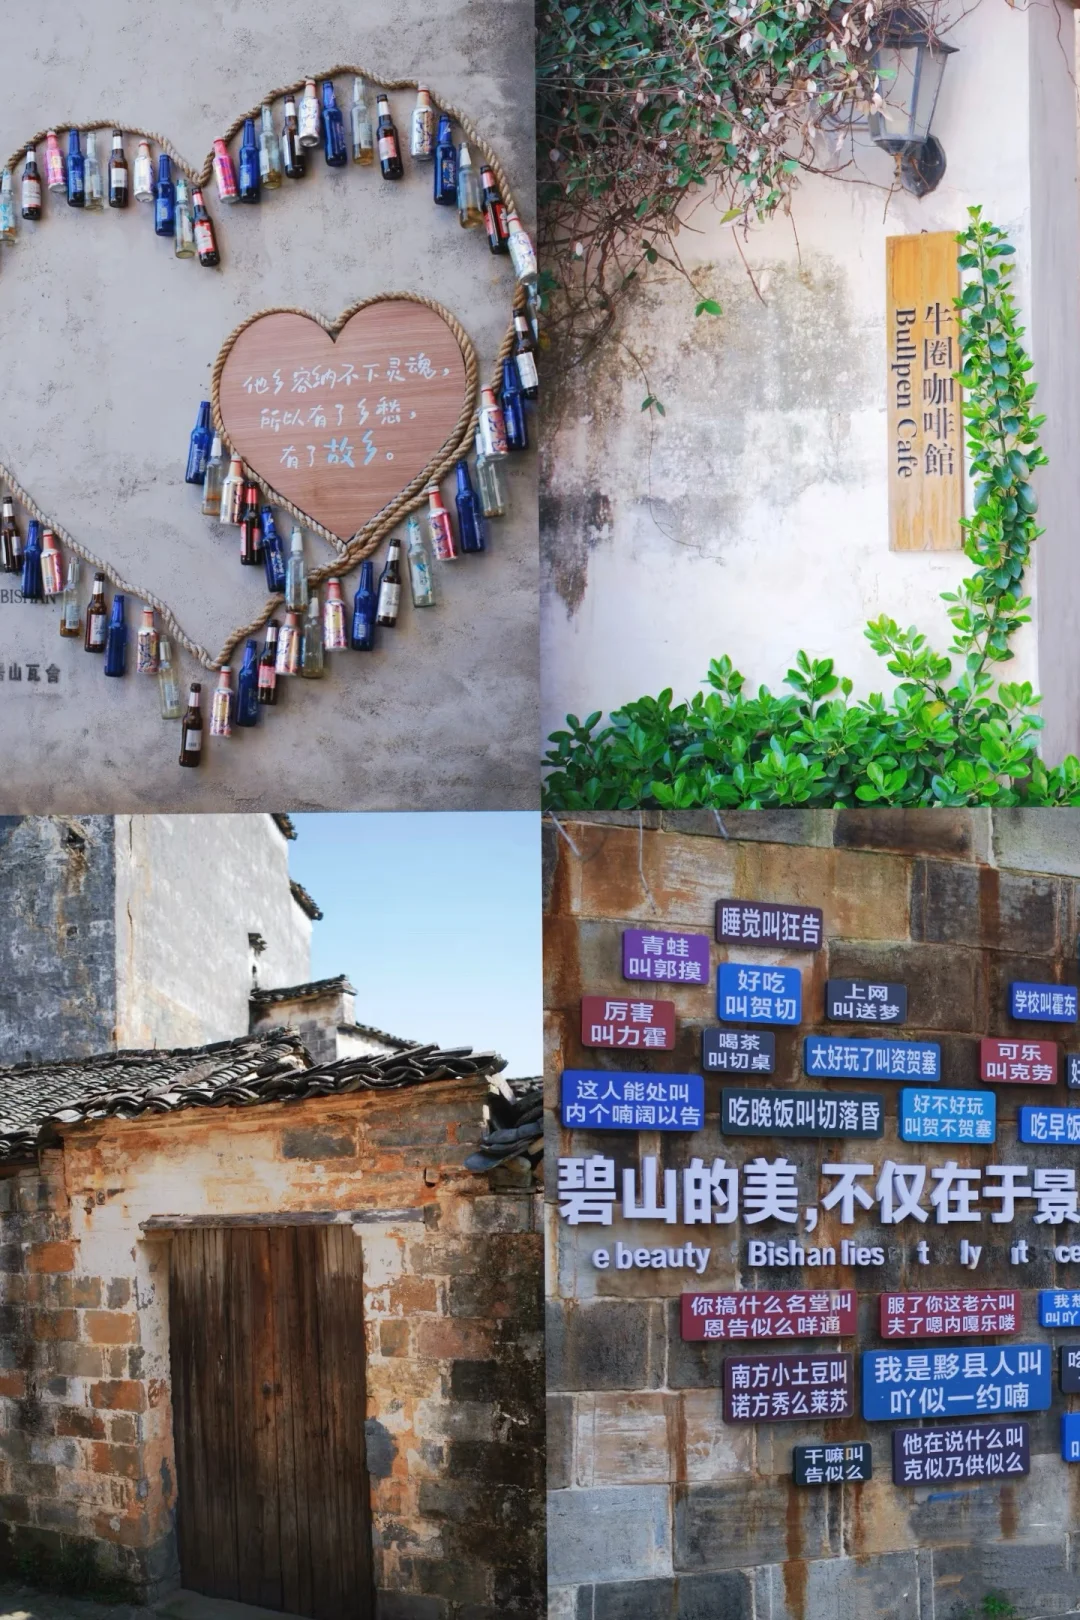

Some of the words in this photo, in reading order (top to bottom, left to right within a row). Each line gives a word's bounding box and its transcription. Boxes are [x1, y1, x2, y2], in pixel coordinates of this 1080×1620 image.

[891, 308, 916, 409] Bullpen
[923, 303, 954, 476] 牛圈咖啡館
[897, 418, 917, 478] Cafe
[722, 907, 820, 944] 睡觉叫狂告
[641, 936, 689, 957] 青蛙
[629, 958, 702, 981] 叫郭摸
[738, 970, 786, 994] 好吃
[844, 983, 889, 1001] 上网
[604, 1001, 654, 1023] 厉害
[726, 996, 797, 1020] 叫贺切
[833, 1002, 900, 1020] 叫送梦
[1015, 990, 1076, 1016] 学校叫霍东
[591, 1025, 667, 1047] 叫力霍
[719, 1033, 760, 1051] 喝茶
[708, 1052, 770, 1070] 叫切桌
[811, 1044, 937, 1075] 太好玩了叫资贺塞
[998, 1043, 1041, 1061] 可乐
[986, 1062, 1053, 1081] 叫克劳
[576, 1080, 689, 1103] 这人能处叫
[566, 1103, 701, 1126] 内个喃阔以告
[728, 1096, 880, 1131] 吃晚饭叫切落昏
[913, 1094, 983, 1115] 好不好玩
[905, 1118, 992, 1138] 叫贺不贺塞
[616, 1241, 711, 1274] beauty
[748, 1239, 836, 1266] Bishan
[840, 1239, 885, 1266] lies
[691, 1293, 852, 1316] 你搞什么名堂叫
[887, 1294, 1015, 1314] 服了你这老六叫
[703, 1316, 840, 1338] 恩告似么咩通
[887, 1314, 1016, 1335] 夫了嗯内嘎乐喽
[731, 1360, 848, 1390] 南方小土豆叫
[874, 1349, 1042, 1384] 我是黟县人叫
[731, 1388, 848, 1419] 诺方秀么莱苏
[890, 1382, 1029, 1415] 吖似一约喃
[903, 1426, 1024, 1456] 他在说什么叫
[804, 1446, 864, 1465] 干嘛叫
[904, 1452, 1024, 1481] 克似乃供似么
[805, 1465, 864, 1483] 告似么
